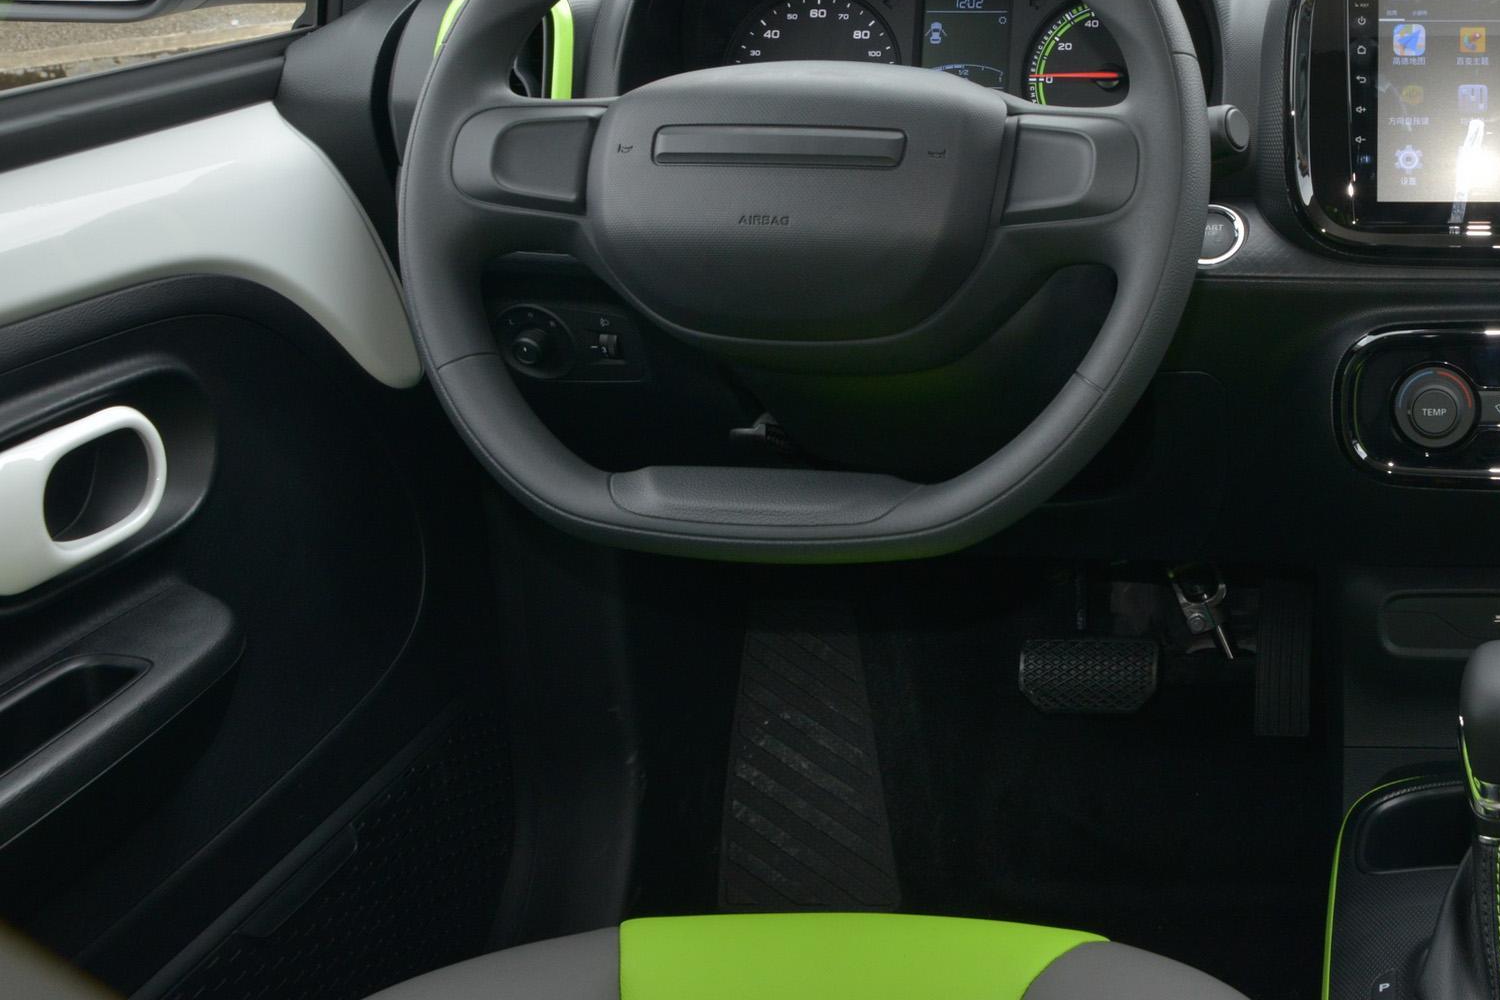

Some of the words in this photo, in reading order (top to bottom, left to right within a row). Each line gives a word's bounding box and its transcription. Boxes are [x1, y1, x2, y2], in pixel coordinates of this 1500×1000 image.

[809, 9, 827, 18] 60
[1084, 19, 1100, 28] 40
[763, 29, 780, 39] 40
[853, 30, 871, 40] 80
[1057, 42, 1073, 51] 20
[749, 49, 761, 57] 30
[868, 50, 882, 58] 100
[1392, 57, 1426, 67] 高德地图
[738, 214, 790, 226] AIRBAG
[1205, 223, 1225, 231] ART
[1421, 407, 1447, 417] TEMP
[1378, 982, 1390, 993] P
